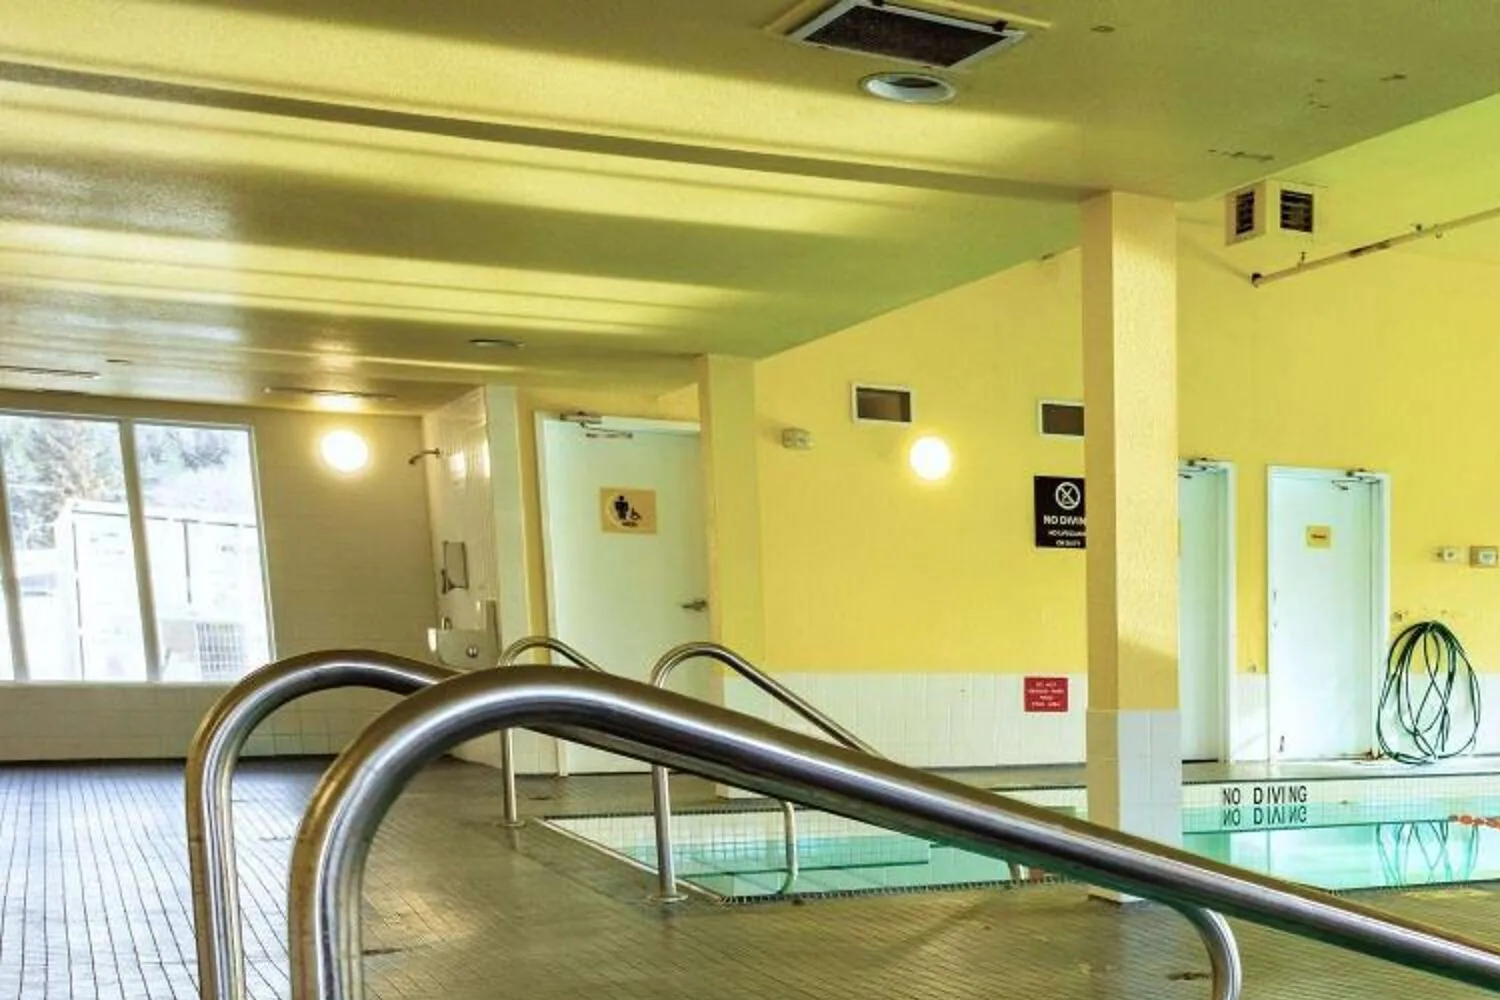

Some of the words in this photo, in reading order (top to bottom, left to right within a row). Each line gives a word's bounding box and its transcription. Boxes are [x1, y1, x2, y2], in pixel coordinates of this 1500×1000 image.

[1059, 515, 1087, 526] DIVIN
[1223, 787, 1241, 805] NO
[1253, 785, 1307, 804] DIVING
